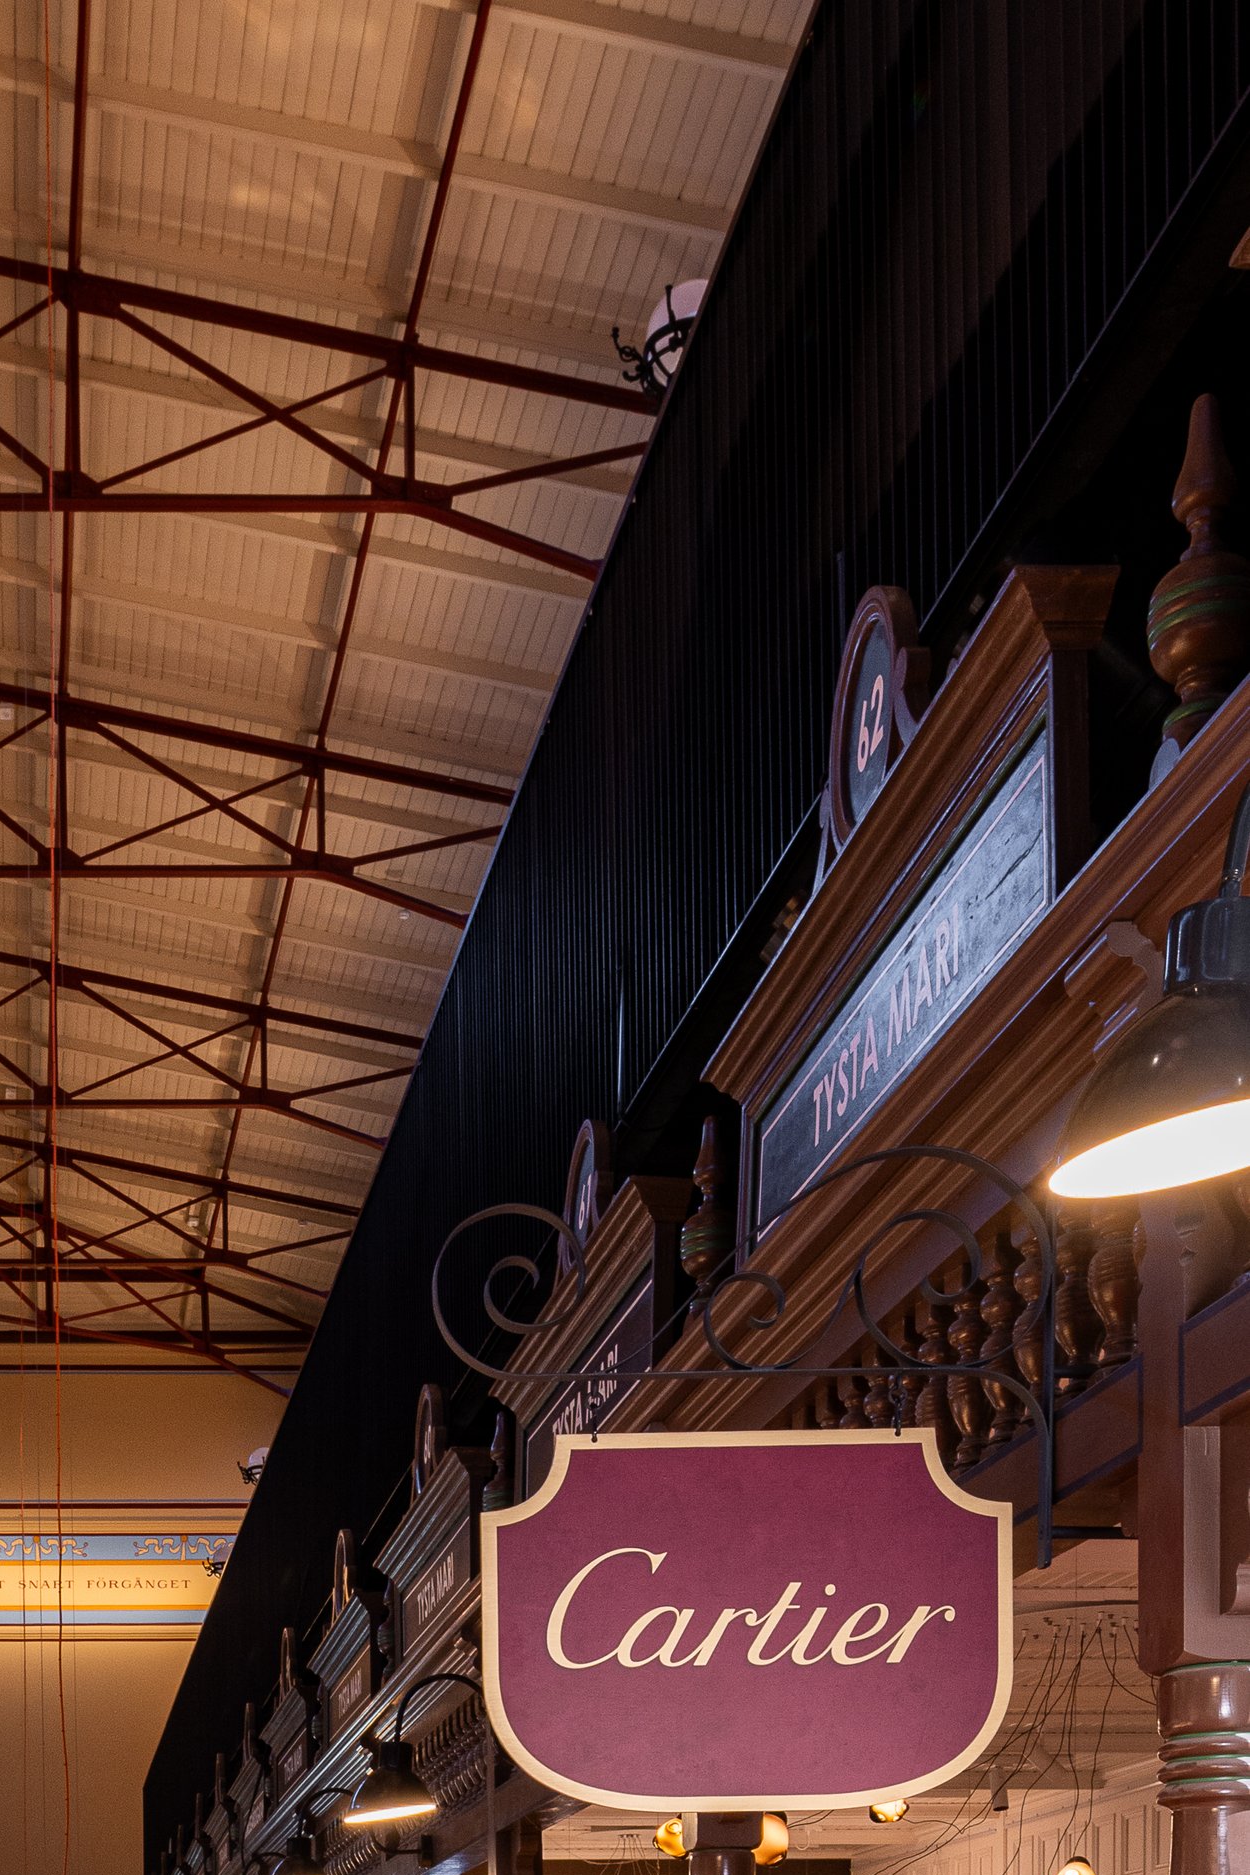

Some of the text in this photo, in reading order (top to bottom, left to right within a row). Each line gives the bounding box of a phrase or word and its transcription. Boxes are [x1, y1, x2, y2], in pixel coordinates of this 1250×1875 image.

[857, 674, 884, 772] 62
[813, 906, 959, 1147] TYSTA MARI
[578, 1173, 592, 1230] 61
[18, 1579, 75, 1590] SNART
[417, 1552, 455, 1625] TYSTA MARI
[546, 1547, 955, 1669] Cartier
